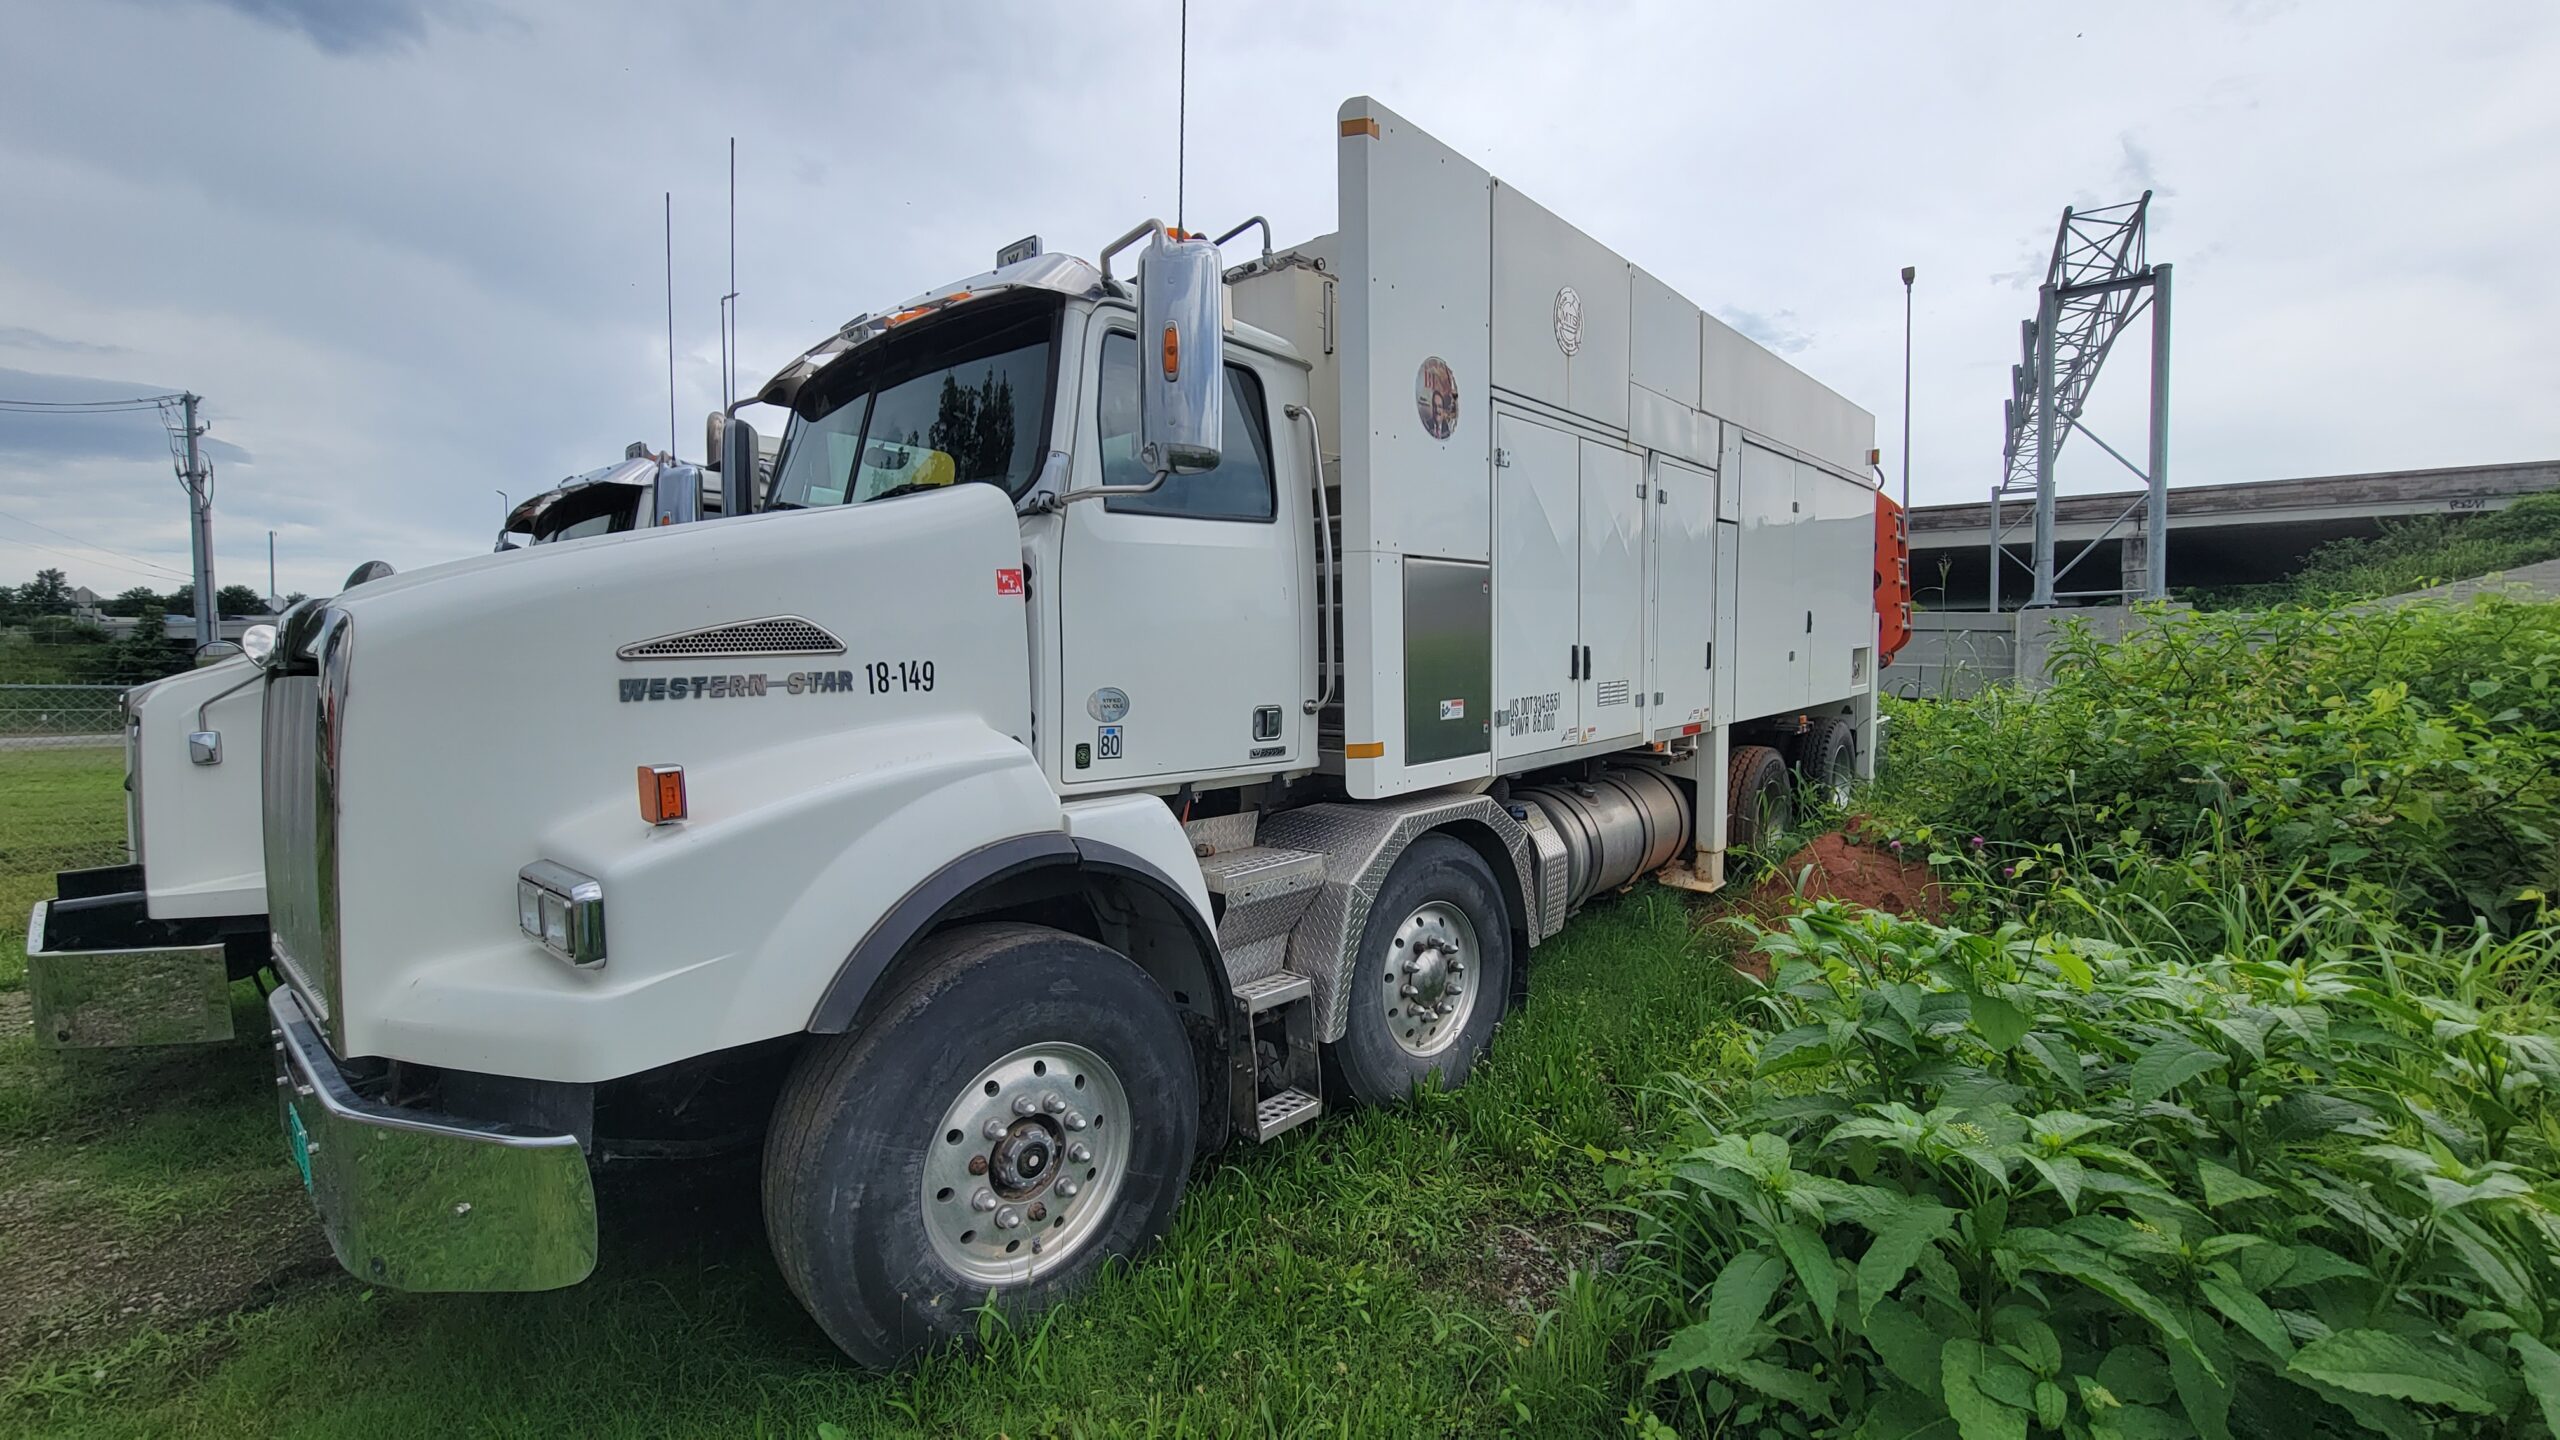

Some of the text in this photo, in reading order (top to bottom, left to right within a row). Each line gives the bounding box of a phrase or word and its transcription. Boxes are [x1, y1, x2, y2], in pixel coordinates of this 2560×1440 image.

[619, 670, 853, 702] WESTERN STAR
[865, 660, 935, 694] 18-149
[1510, 698, 1519, 718] US
[1101, 735, 1119, 756] 80
